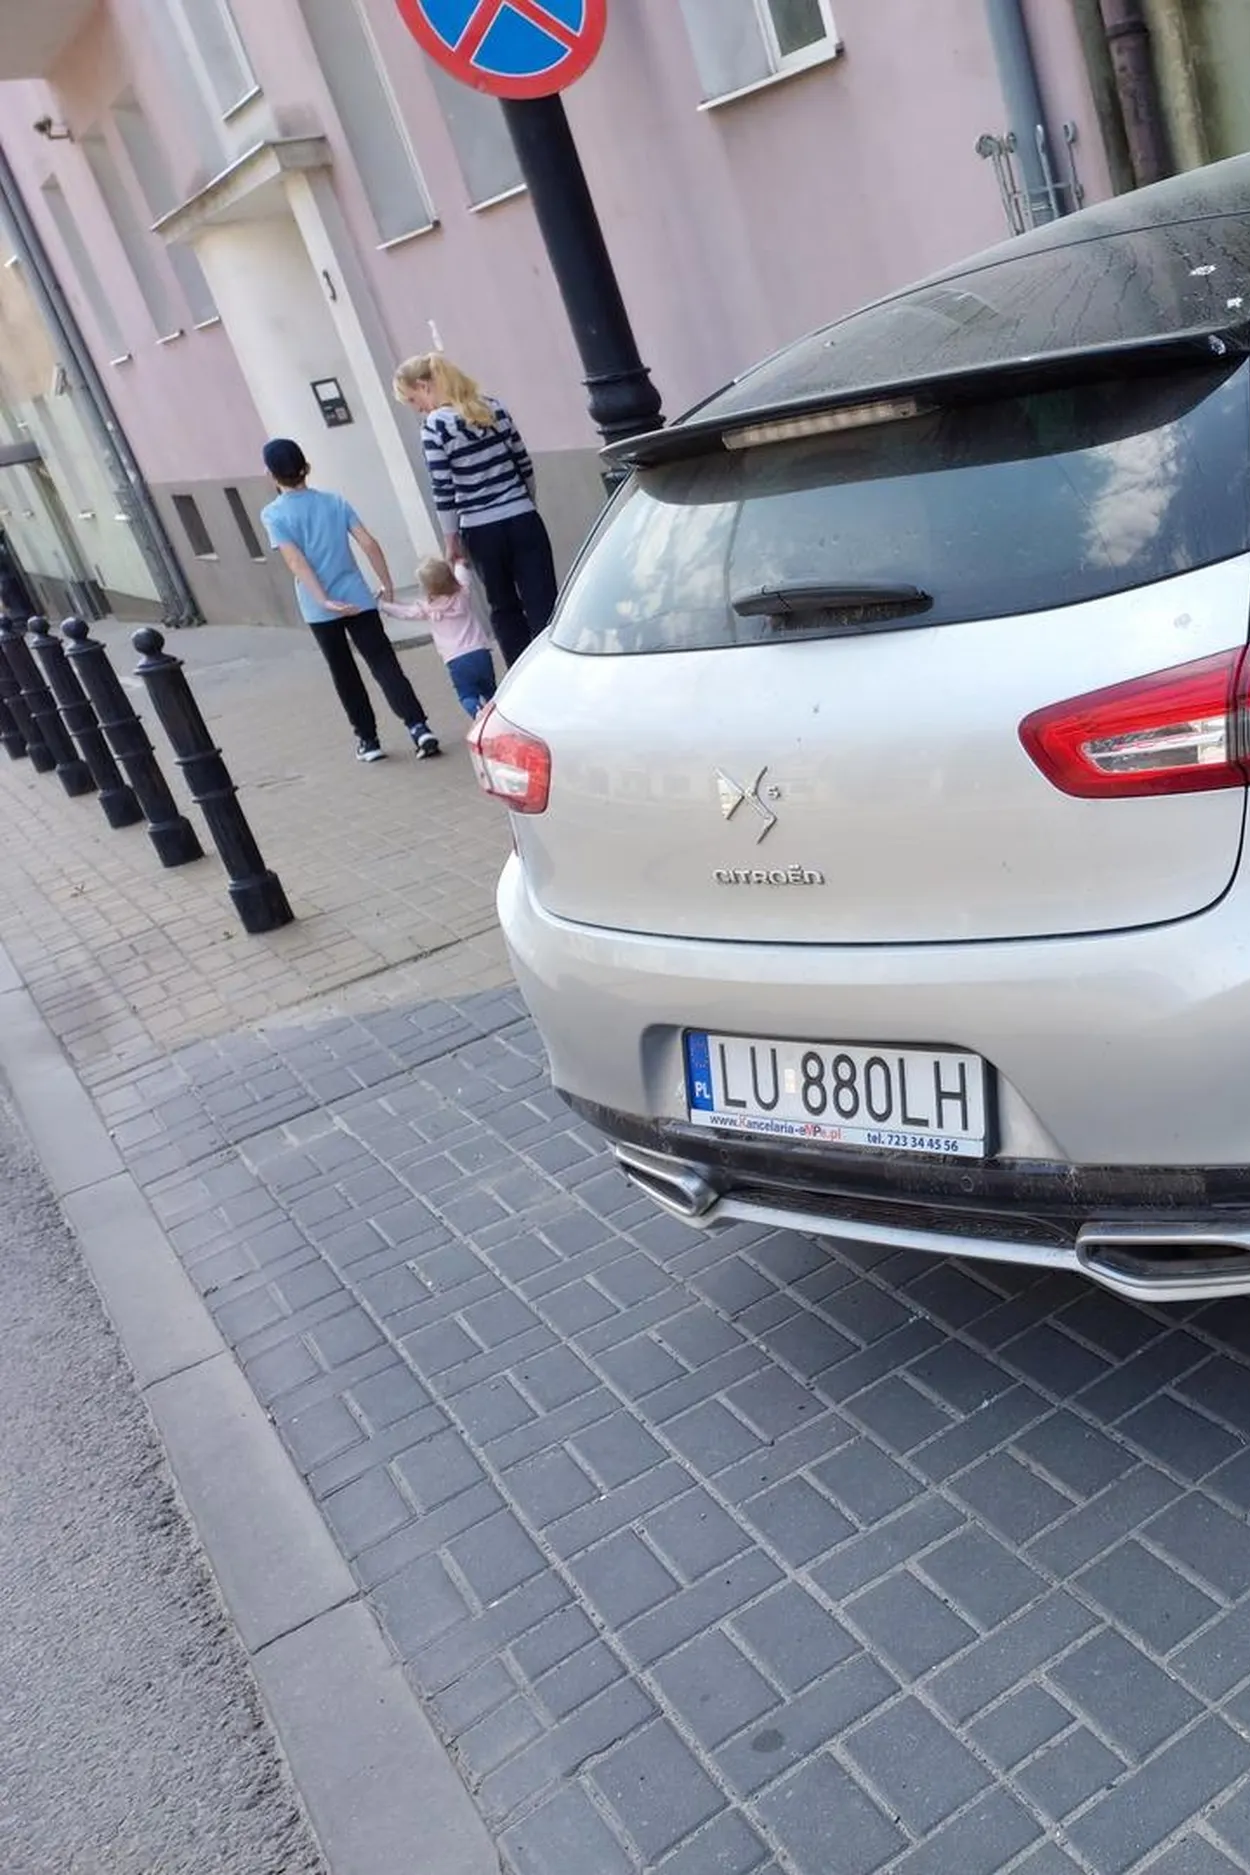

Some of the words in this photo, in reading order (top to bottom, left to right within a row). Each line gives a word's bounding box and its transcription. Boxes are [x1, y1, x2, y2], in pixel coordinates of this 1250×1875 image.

[718, 1043, 780, 1111] LU
[694, 1080, 711, 1099] PL
[867, 1132, 885, 1145] tel.
[887, 1134, 907, 1147] 723
[910, 1136, 925, 1149] 34
[926, 1138, 942, 1151] 45
[944, 1140, 959, 1152] 56
